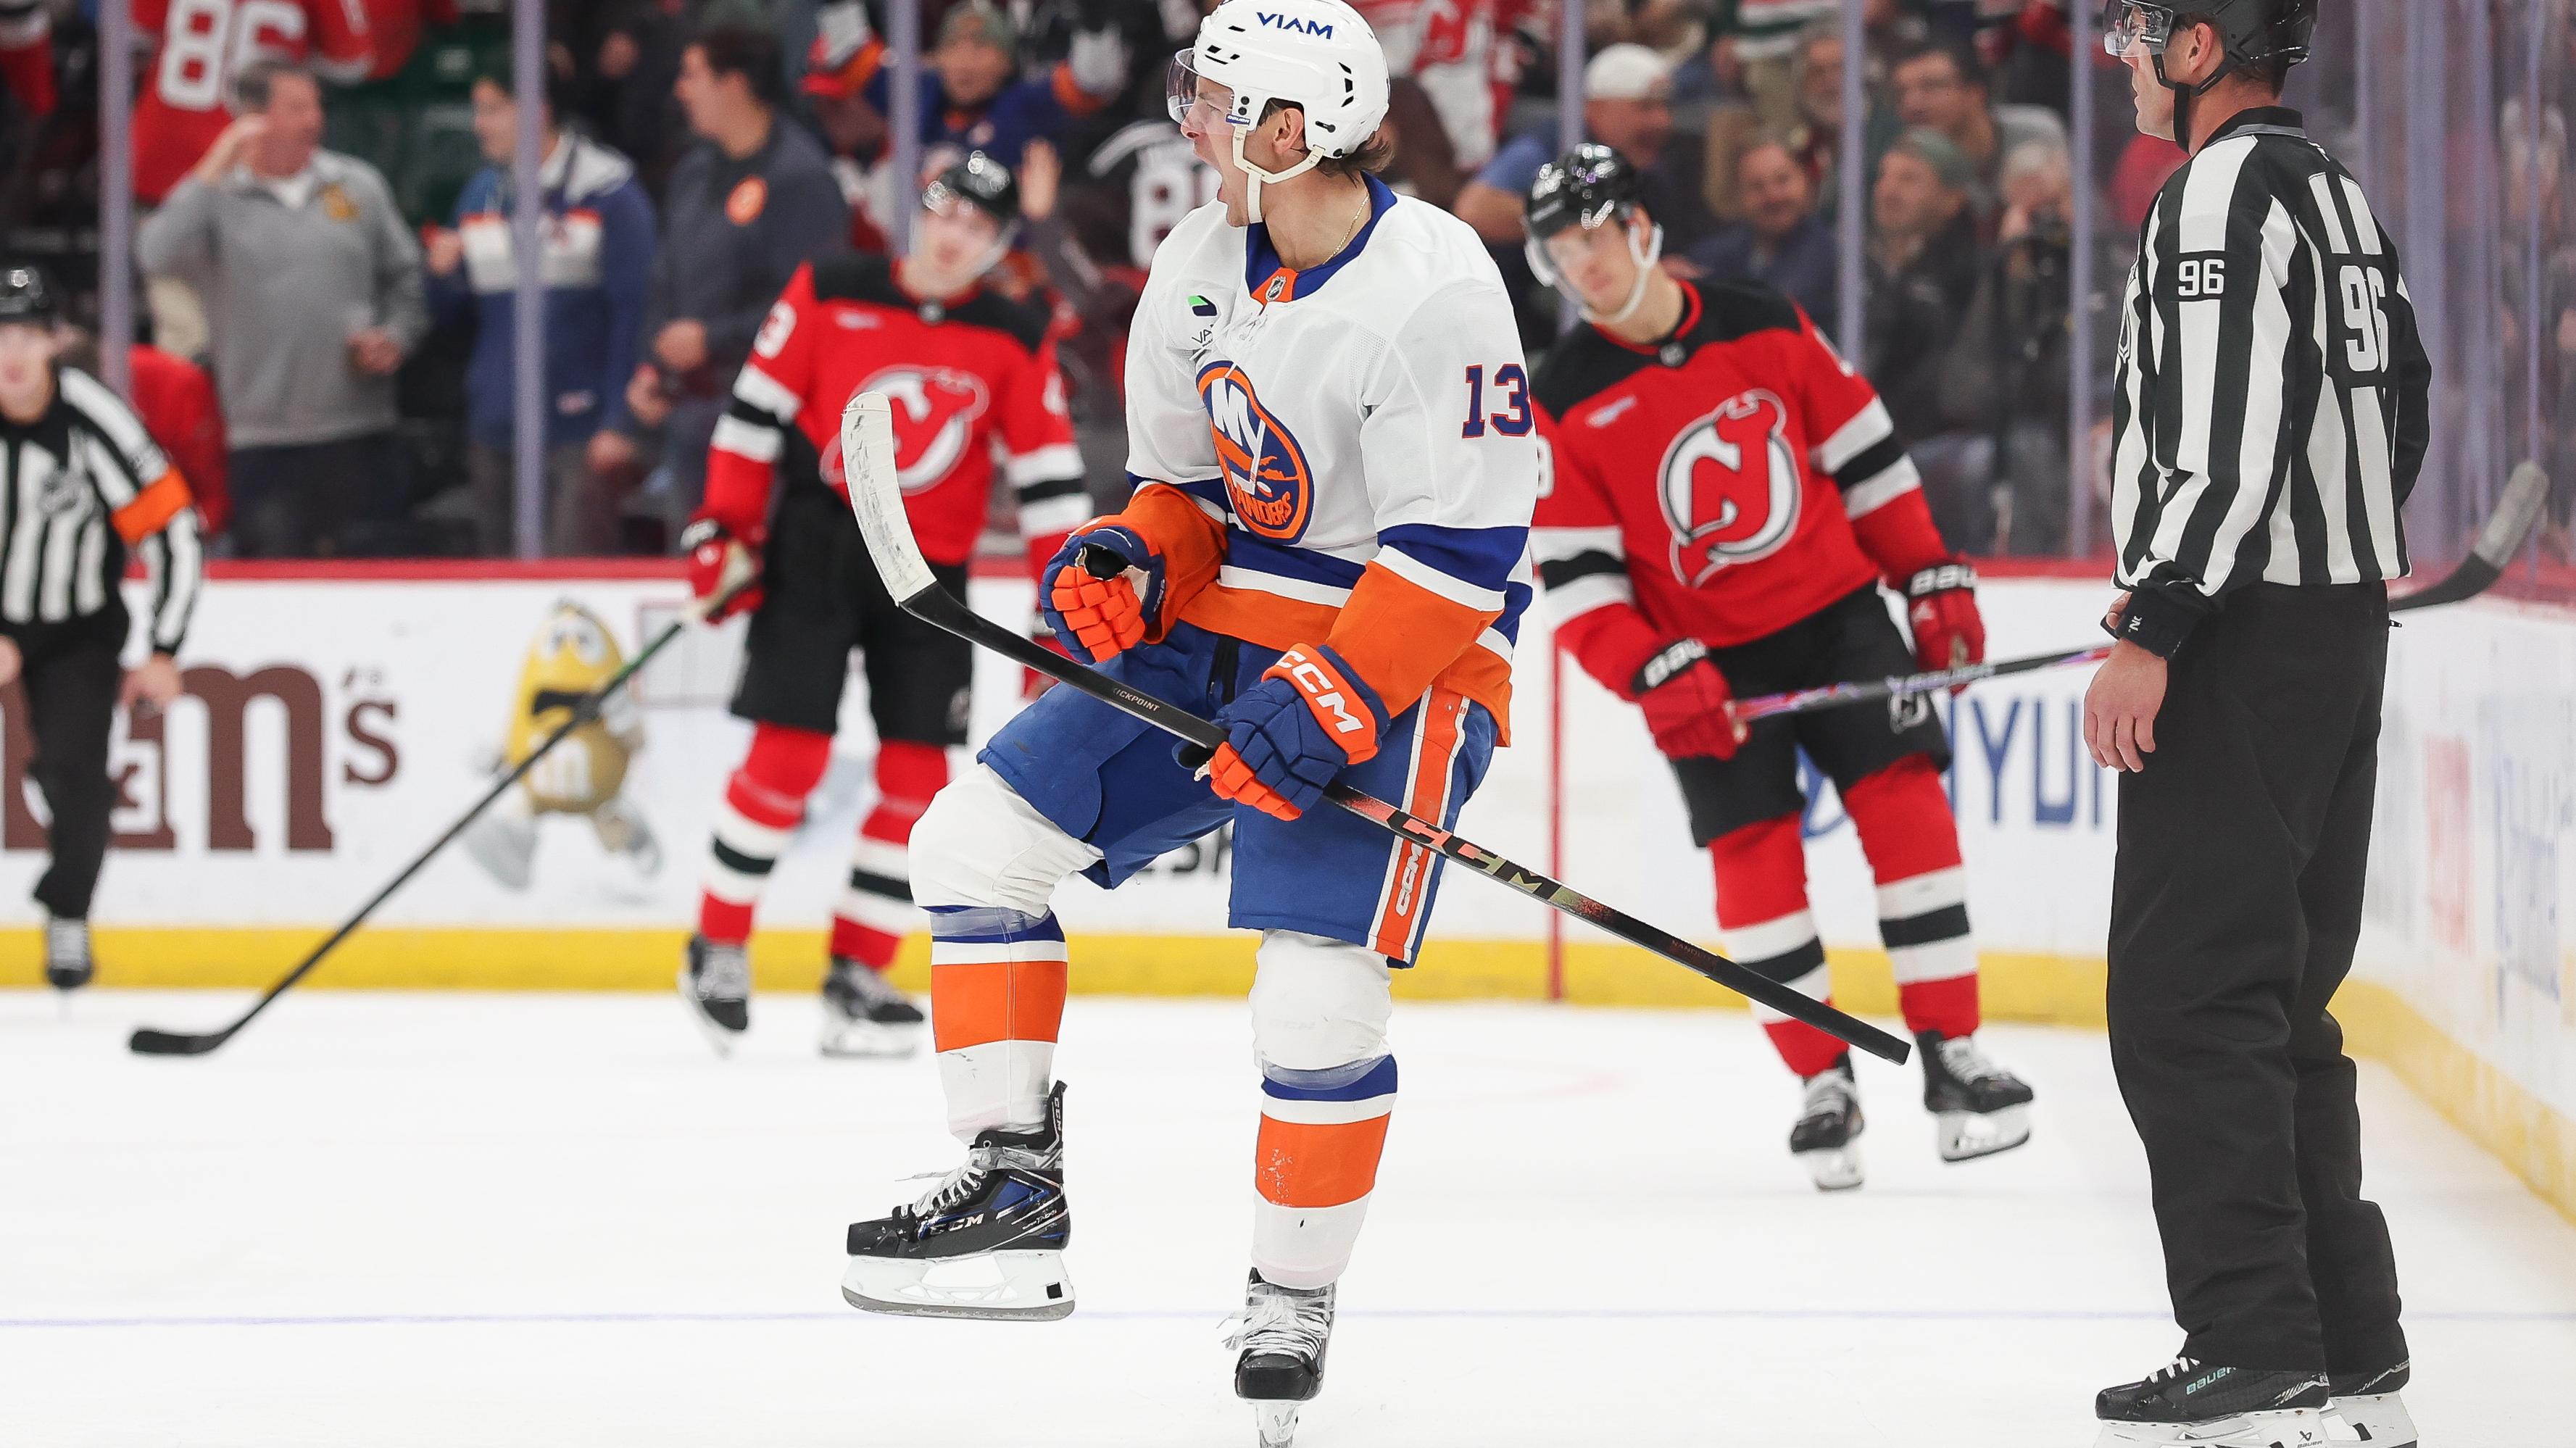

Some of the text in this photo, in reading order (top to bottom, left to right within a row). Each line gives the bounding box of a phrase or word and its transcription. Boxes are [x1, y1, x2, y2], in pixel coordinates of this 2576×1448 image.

[1256, 12, 1333, 40] VIAM
[2178, 259, 2225, 296] 96
[2339, 265, 2389, 373] 96
[1461, 363, 1534, 438] 13
[1275, 650, 1364, 733] CCM
[1387, 810, 1562, 900] CCM
[1395, 842, 1424, 917] CCM
